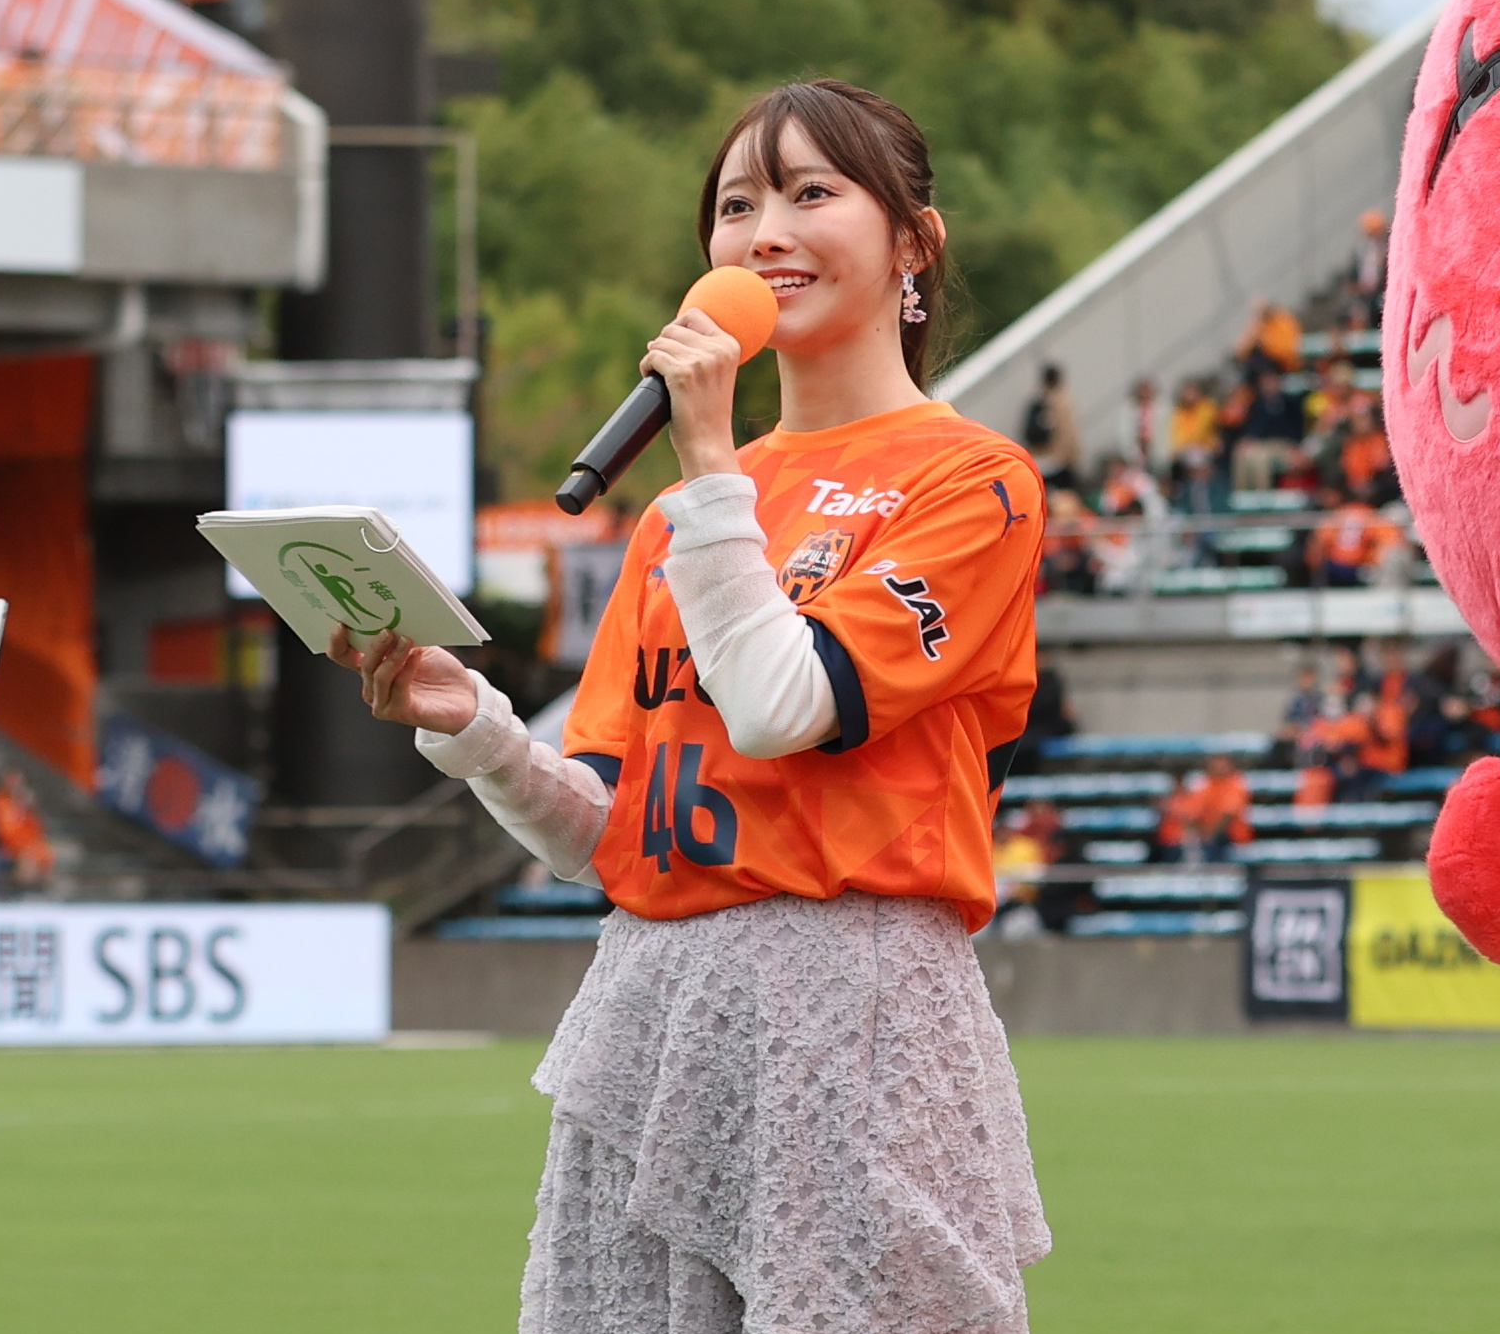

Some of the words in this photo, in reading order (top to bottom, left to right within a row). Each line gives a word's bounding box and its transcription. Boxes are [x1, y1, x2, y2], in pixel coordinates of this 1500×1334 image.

[806, 478, 906, 518] Taica
[881, 573, 950, 662] JAL
[642, 742, 737, 873] 46
[93, 924, 247, 1024] SBS
